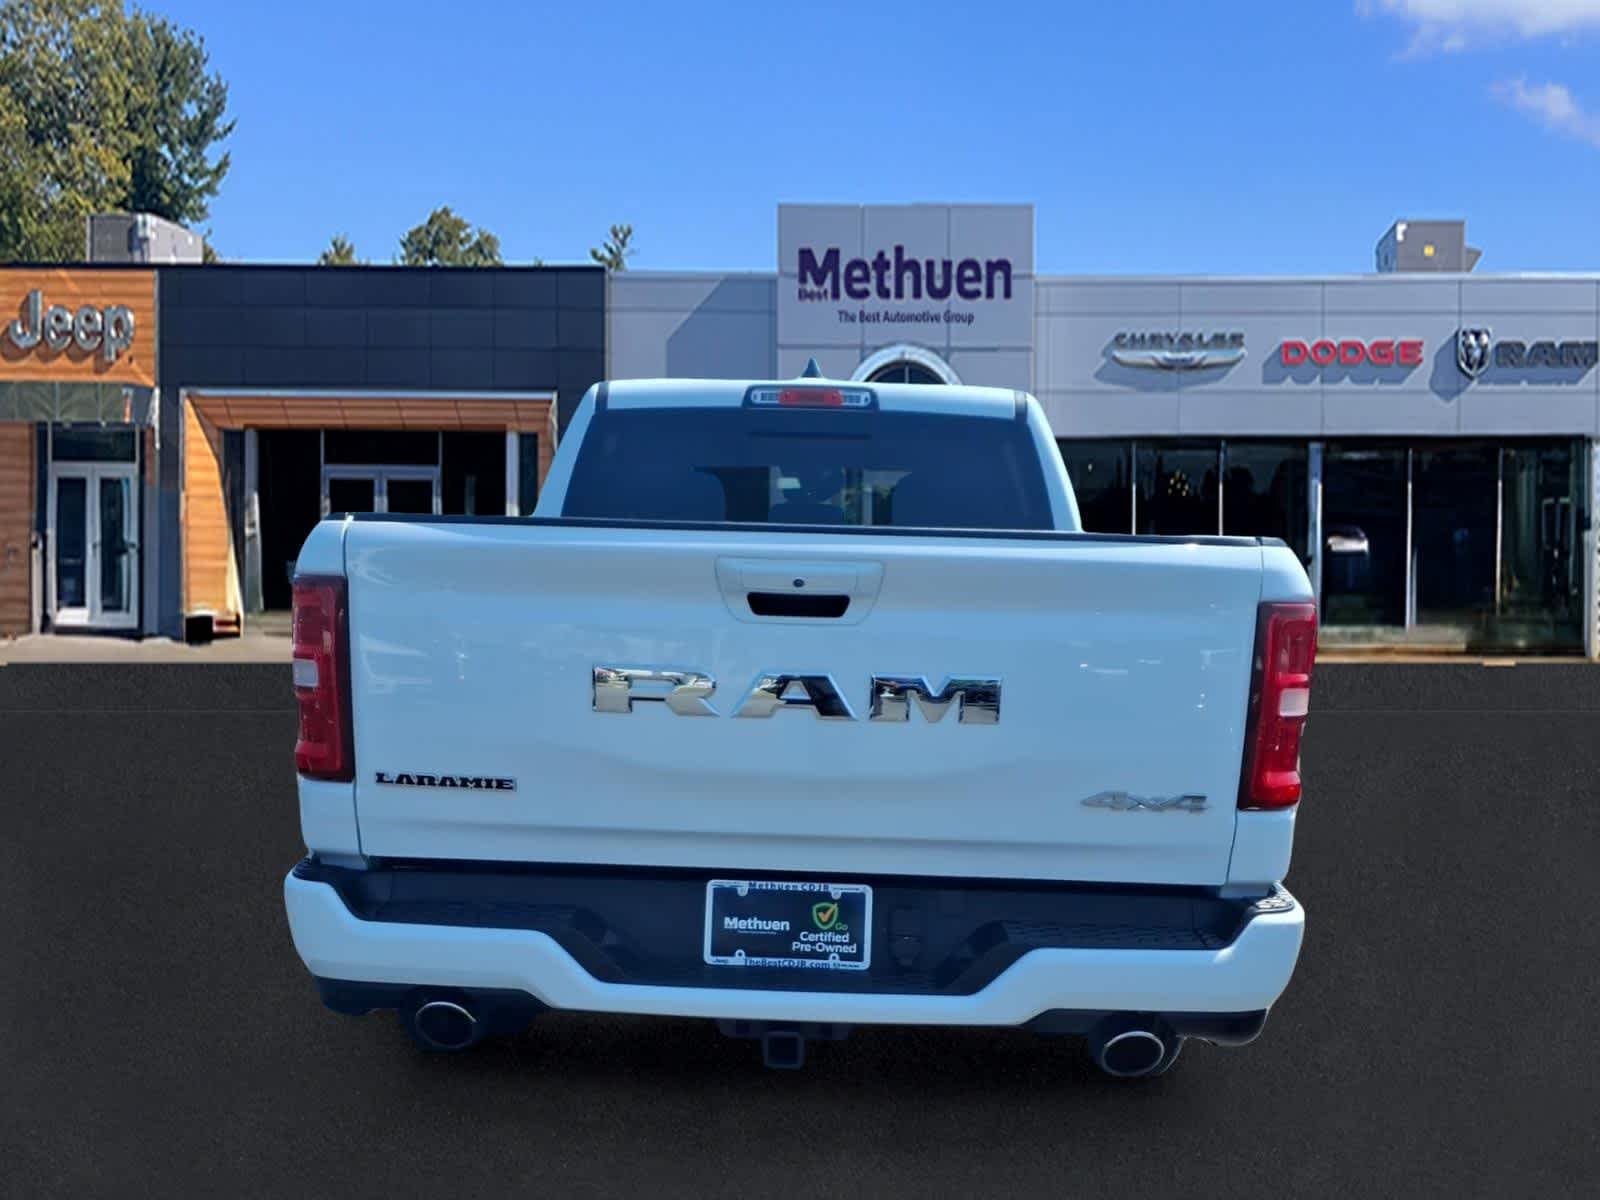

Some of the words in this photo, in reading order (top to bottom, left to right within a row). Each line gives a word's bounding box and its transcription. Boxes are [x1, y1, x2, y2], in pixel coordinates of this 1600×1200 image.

[798, 245, 1012, 300] Methuen
[9, 289, 135, 362] Jeep
[838, 310, 857, 323] The
[859, 310, 881, 323] Best
[883, 310, 941, 323] Automotive
[943, 310, 975, 325] Group
[1114, 332, 1245, 350] CHRYSLER
[1281, 340, 1424, 366] DODGE
[1495, 341, 1598, 368] RAM
[592, 665, 1003, 725] RAM
[376, 772, 516, 791] LARAMIE
[723, 917, 790, 931] Methuen
[800, 931, 850, 943] Certified
[792, 942, 856, 953] Pre-Owned
